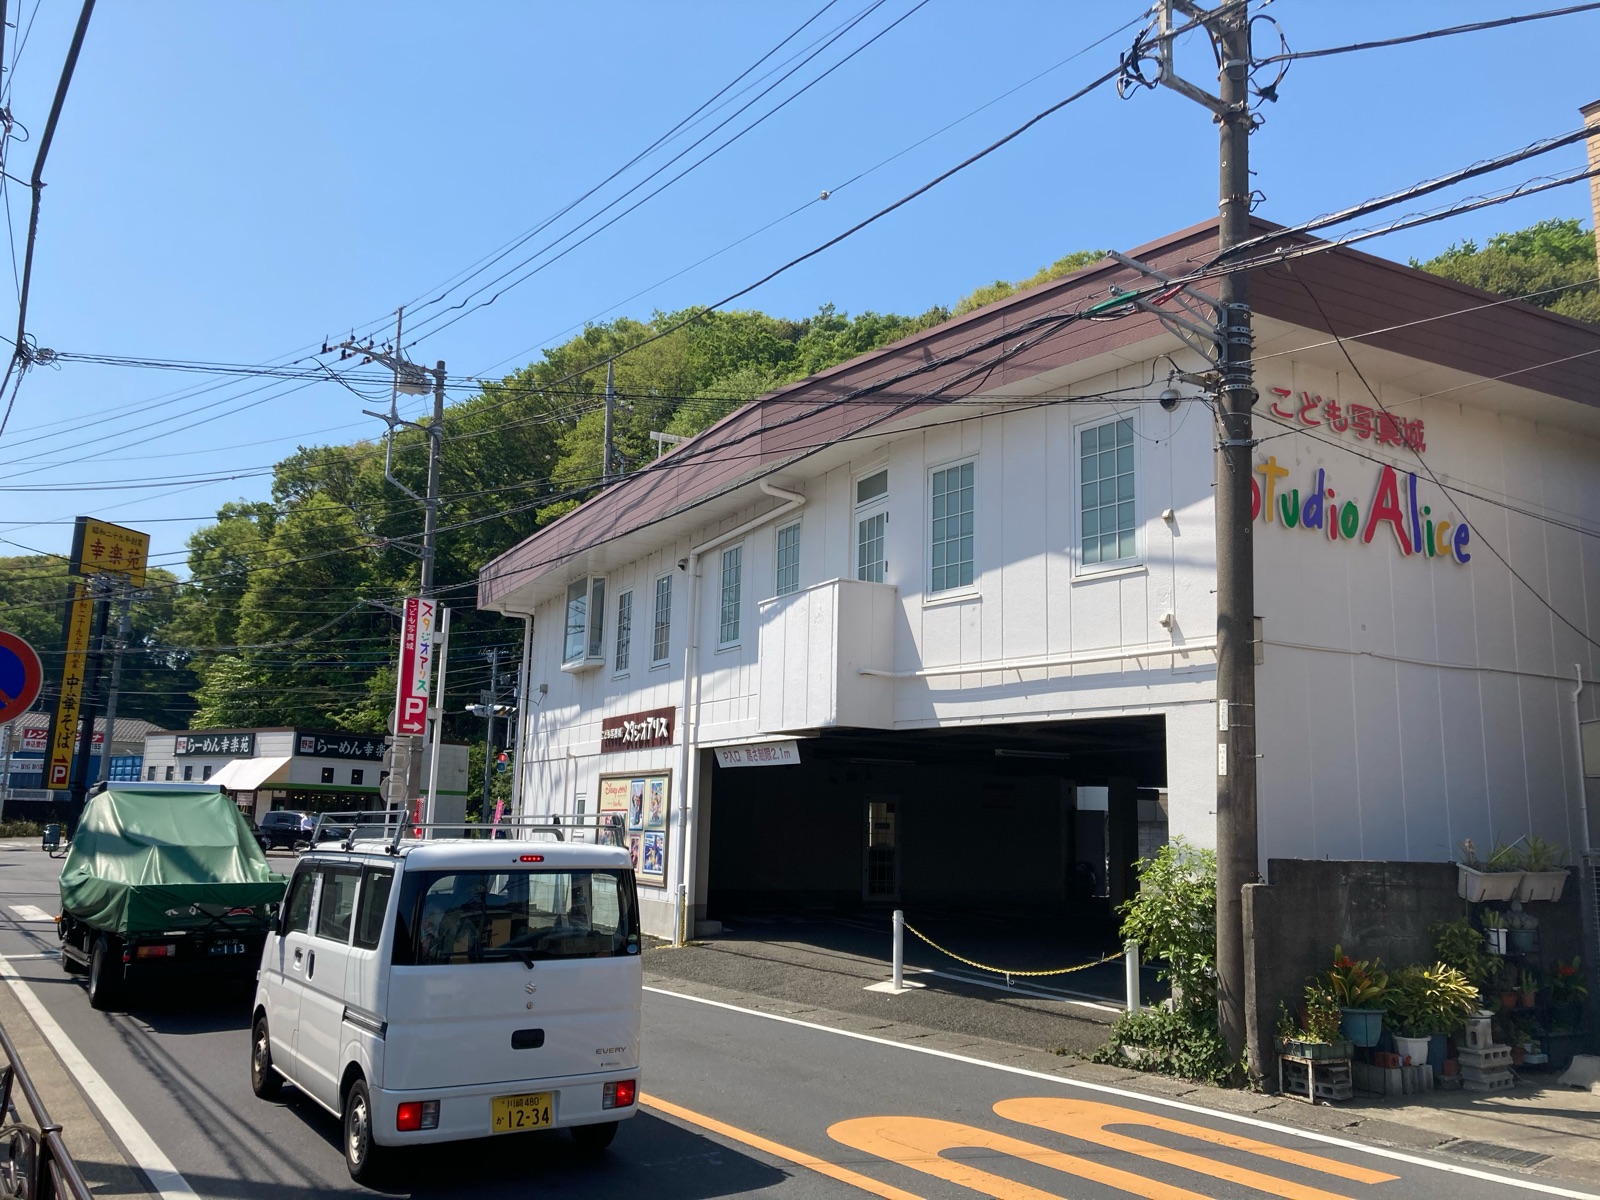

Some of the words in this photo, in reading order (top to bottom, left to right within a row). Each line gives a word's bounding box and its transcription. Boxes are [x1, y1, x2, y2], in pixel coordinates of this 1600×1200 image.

[1271, 386, 1427, 453] こども写真城
[1362, 464, 1471, 564] Alice
[90, 537, 141, 570] 幸楽苑
[416, 601, 434, 693] スタジオアリス
[56, 673, 80, 749] 中華そば
[404, 697, 424, 721] P
[622, 716, 669, 743] スタジオアリス
[52, 766, 67, 783] P
[595, 1046, 627, 1055] EVERY
[507, 1096, 540, 1108] 川崎480
[508, 1106, 550, 1128] 12-34
